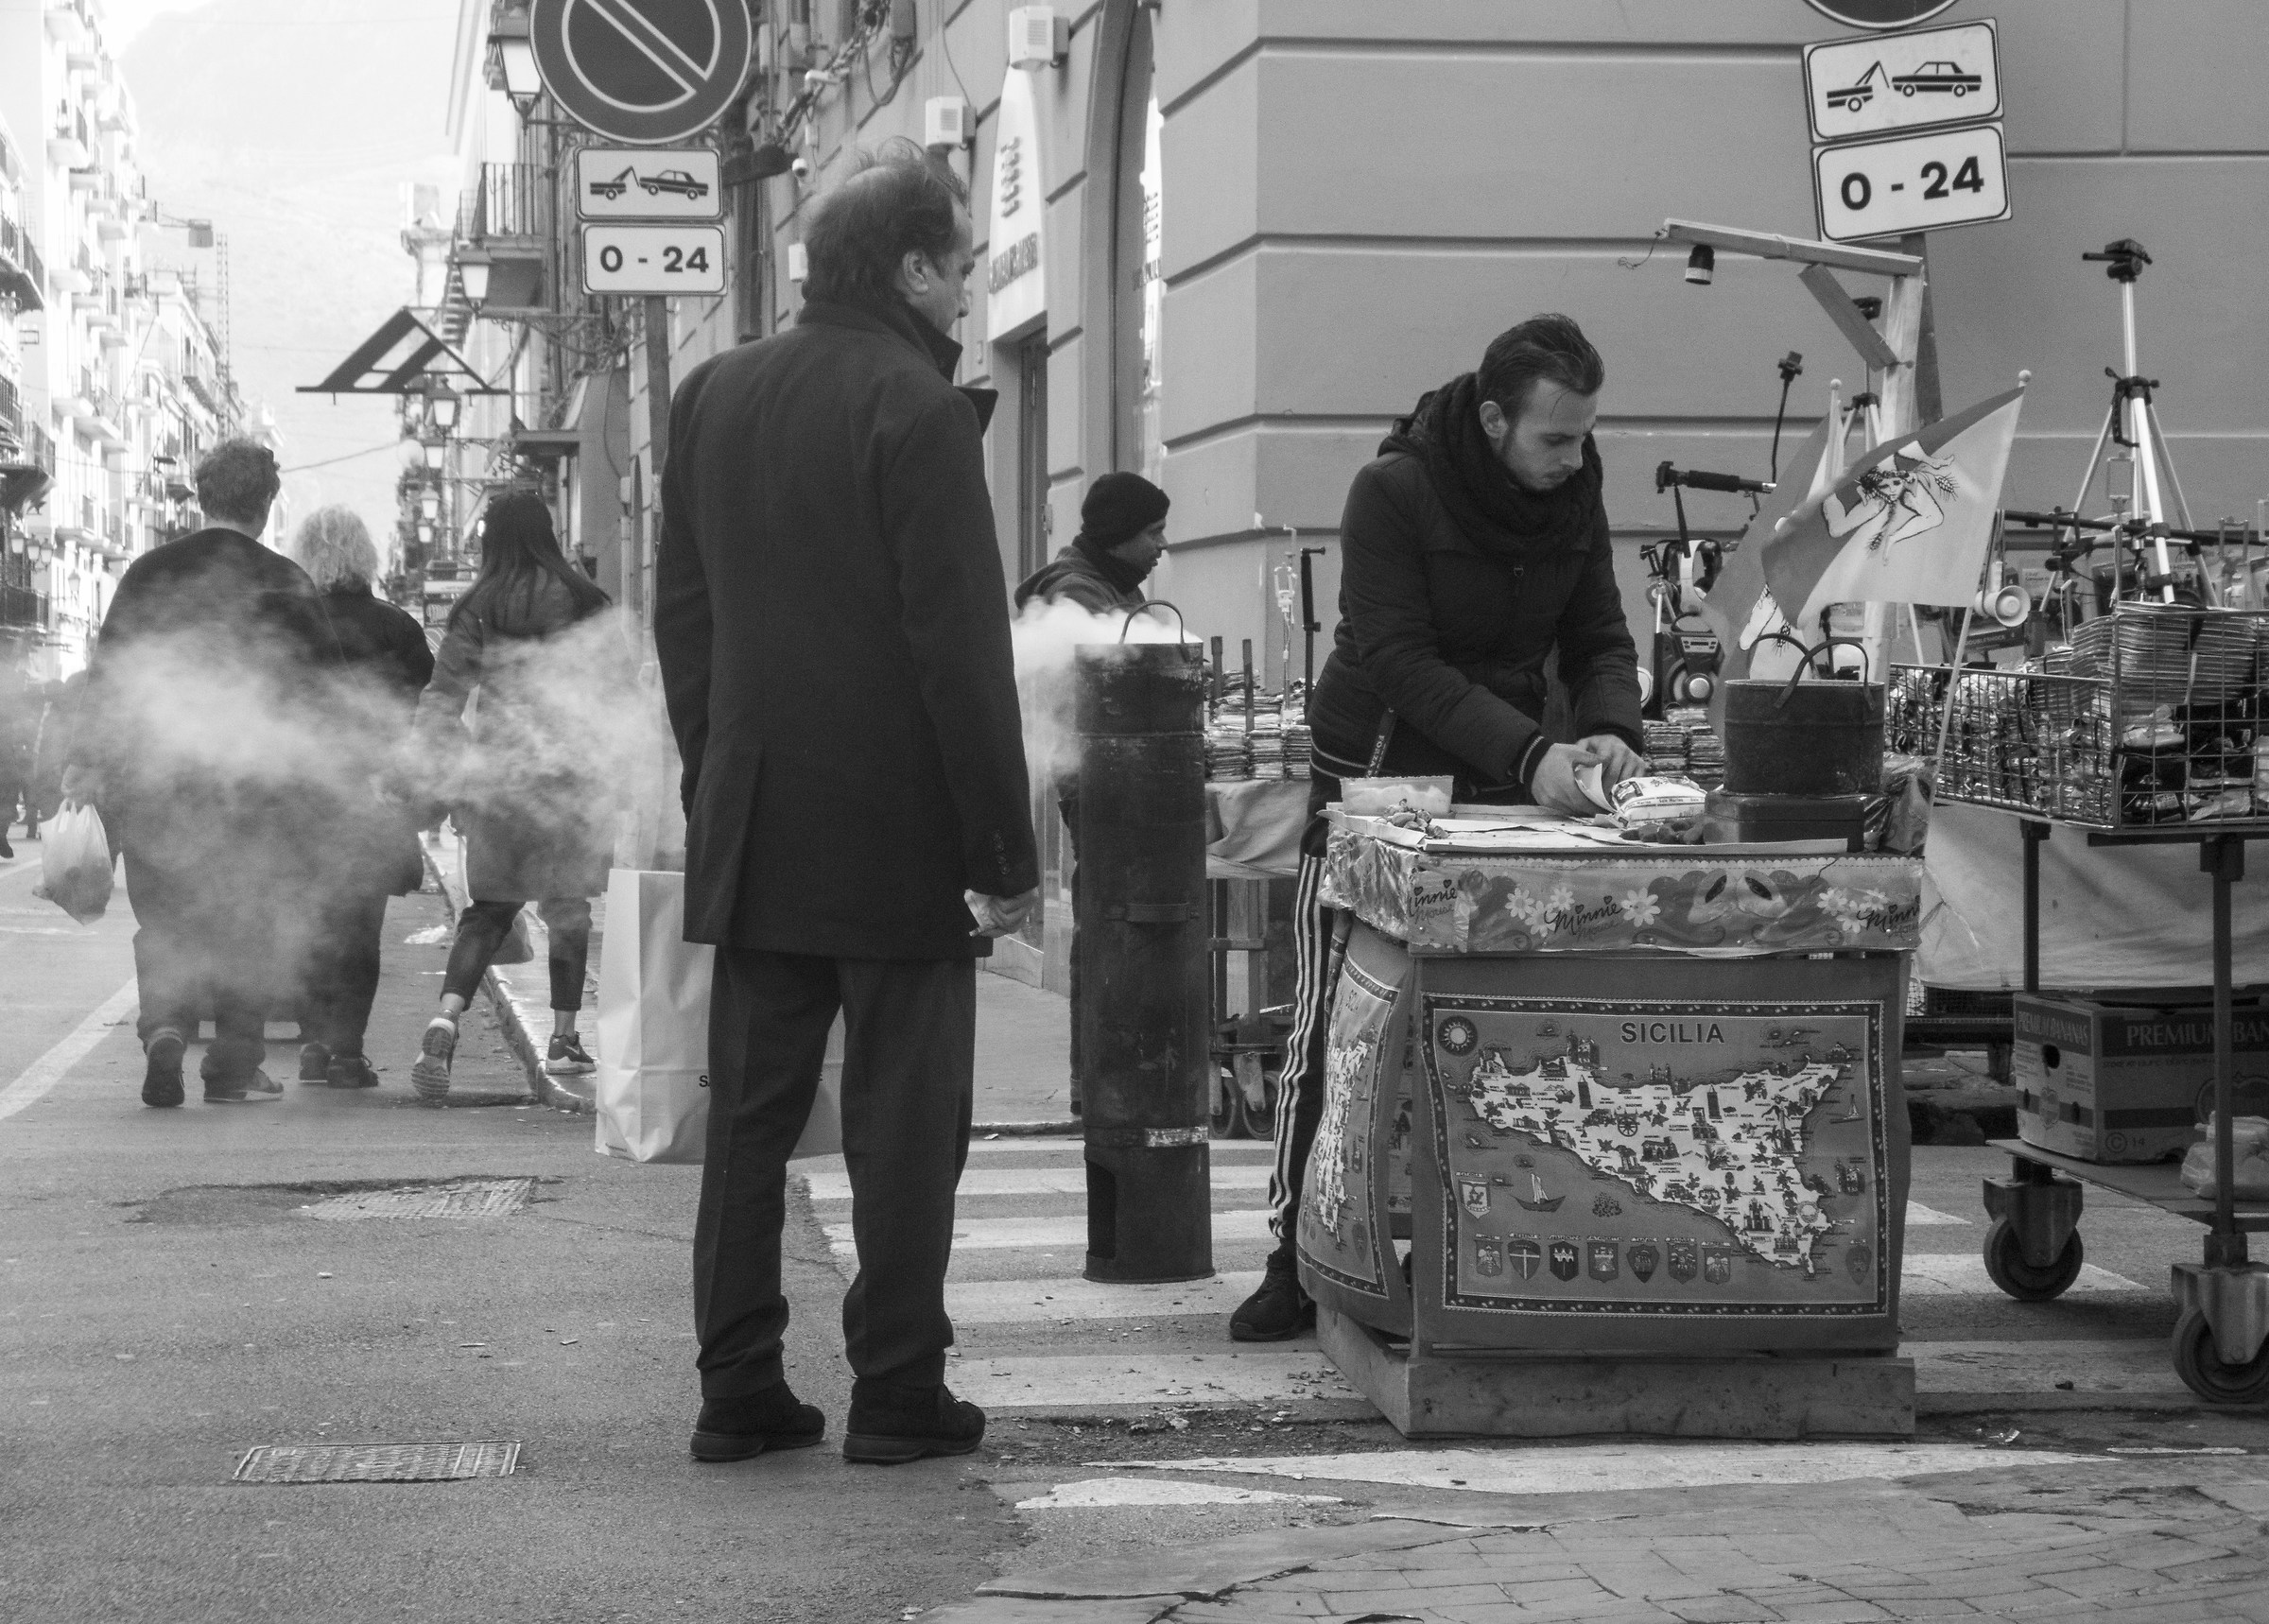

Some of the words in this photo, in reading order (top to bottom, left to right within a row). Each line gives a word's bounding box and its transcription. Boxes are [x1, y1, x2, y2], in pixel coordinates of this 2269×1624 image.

[1841, 171, 1872, 211] 0
[1891, 182, 1904, 192] -
[1920, 155, 1984, 200] 24
[599, 245, 624, 273] 0
[663, 245, 709, 273] 24
[1543, 895, 1624, 936] Minnie
[1620, 1022, 1725, 1045] SICILIA
